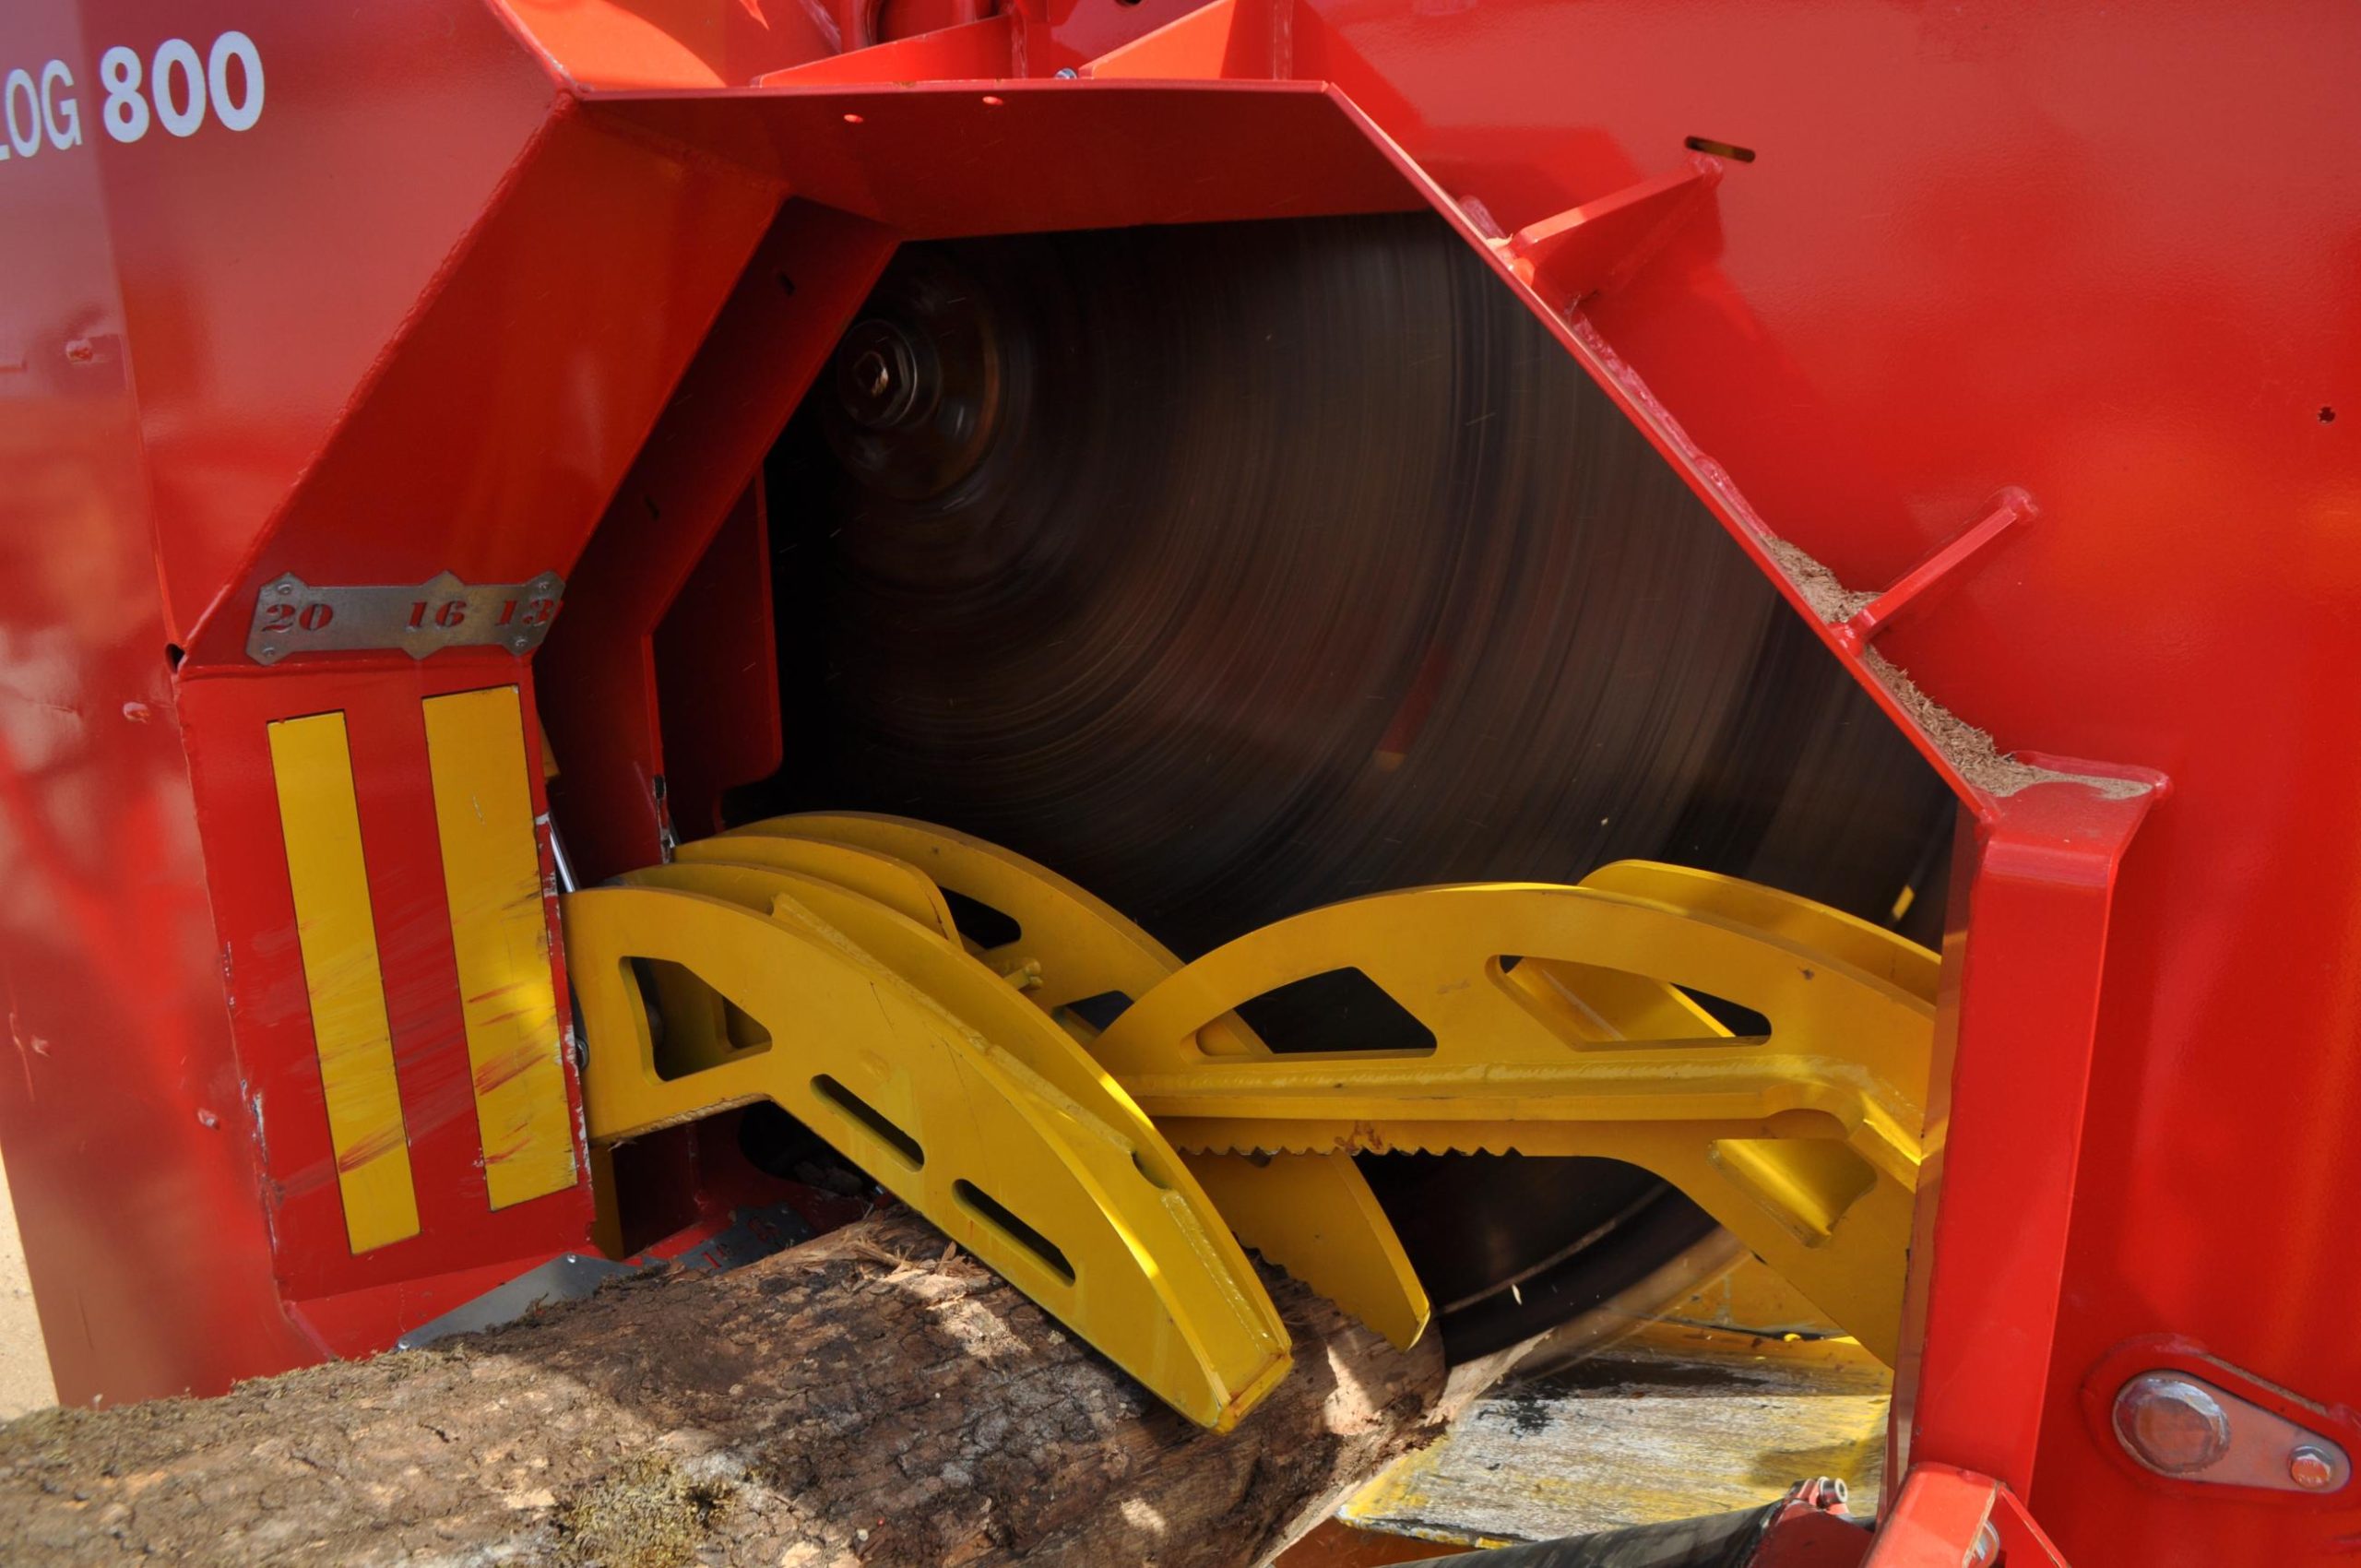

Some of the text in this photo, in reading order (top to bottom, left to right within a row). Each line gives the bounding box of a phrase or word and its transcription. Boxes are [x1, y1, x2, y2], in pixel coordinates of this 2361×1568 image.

[101, 30, 265, 143] 800
[262, 599, 554, 633] 20 16 13
